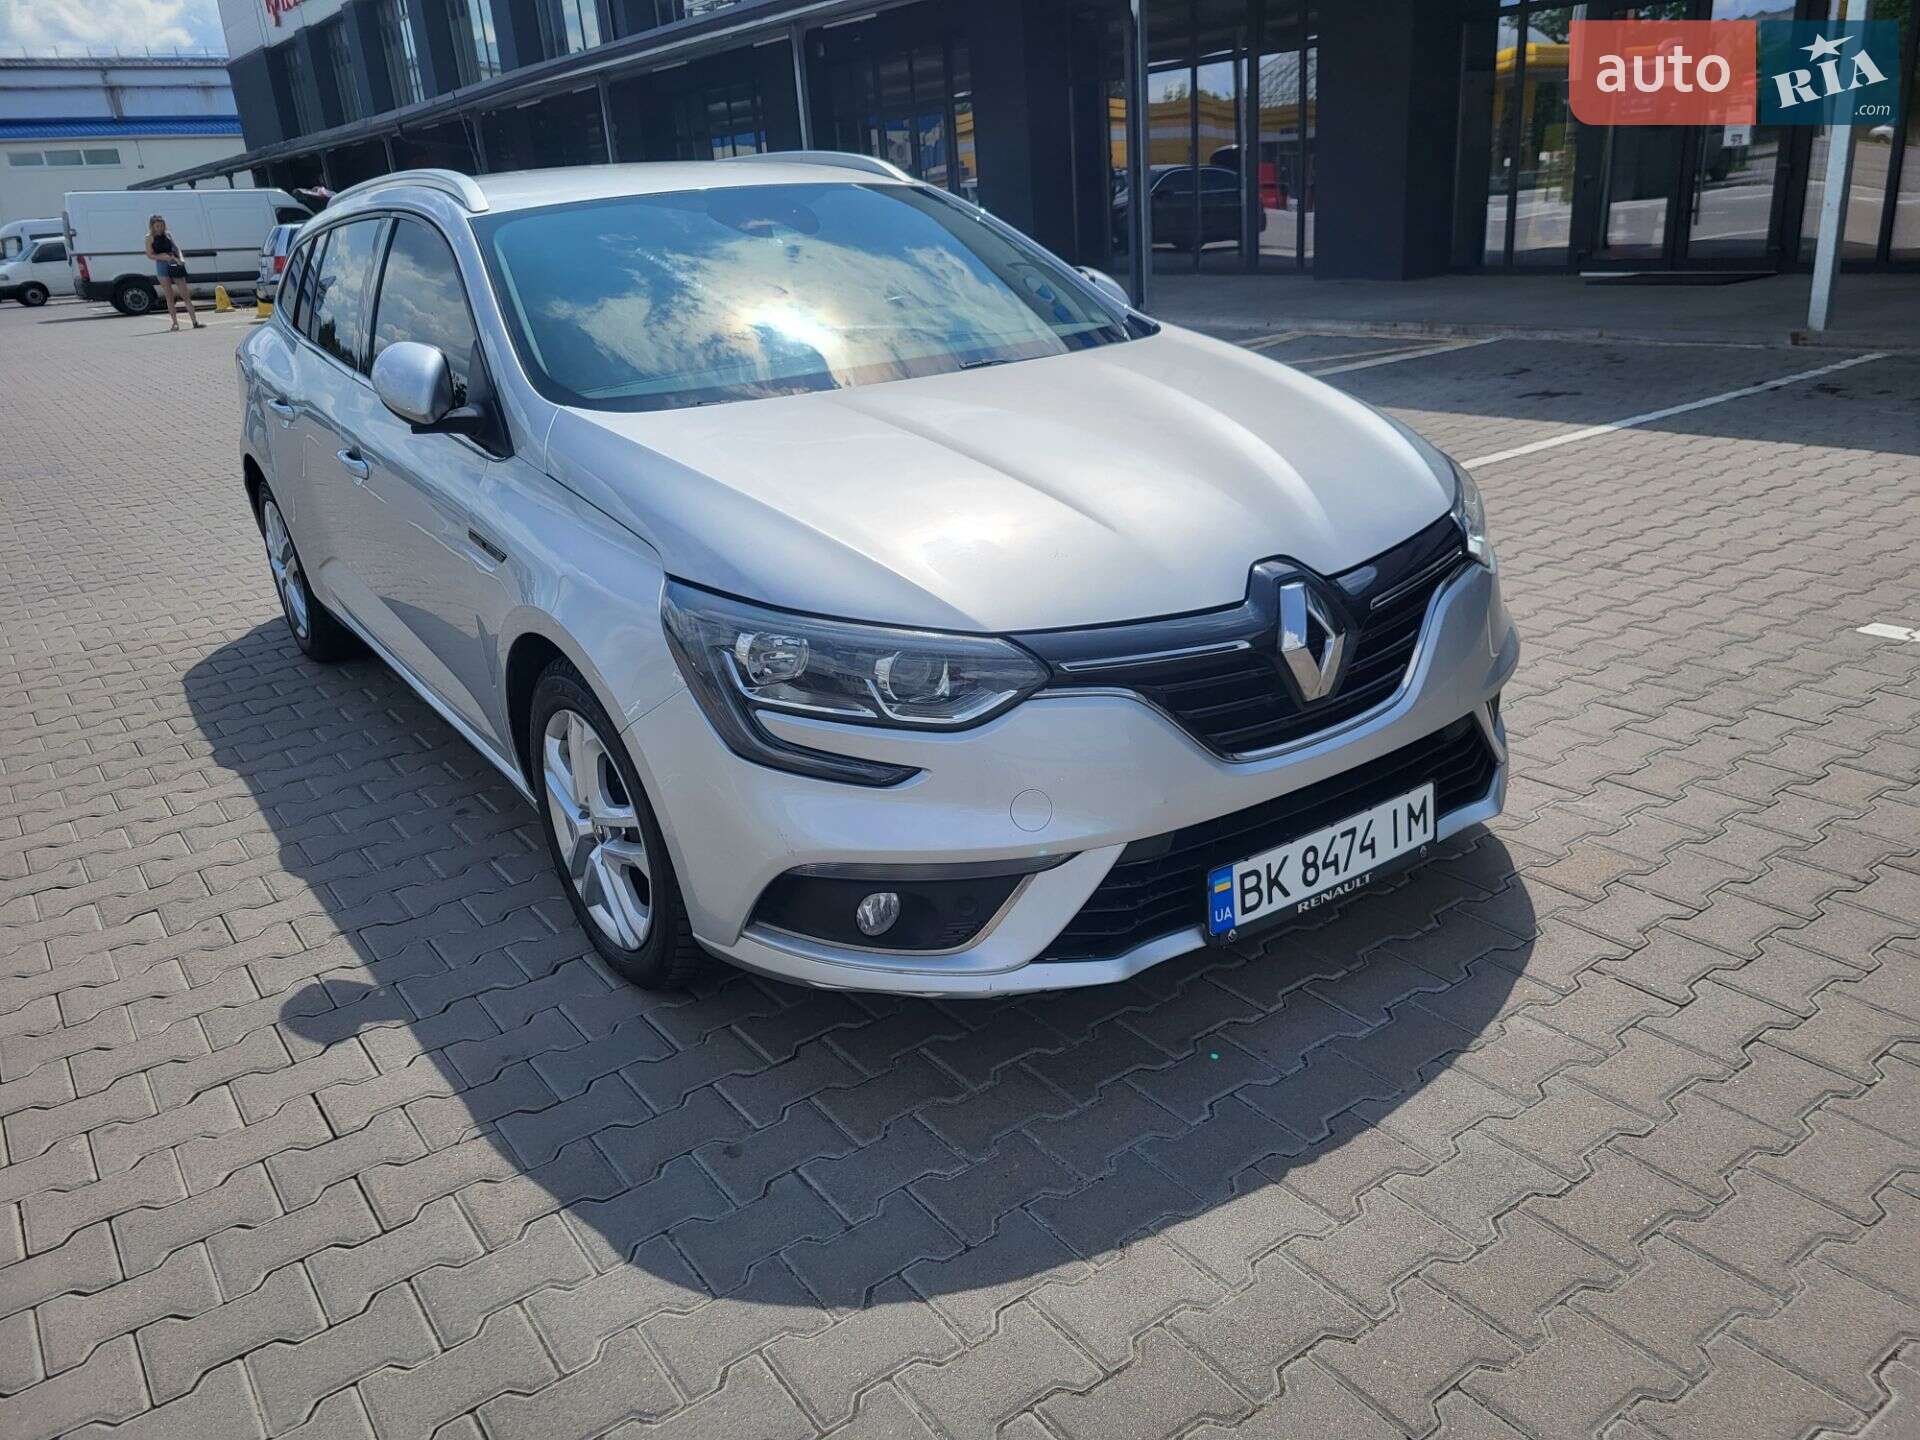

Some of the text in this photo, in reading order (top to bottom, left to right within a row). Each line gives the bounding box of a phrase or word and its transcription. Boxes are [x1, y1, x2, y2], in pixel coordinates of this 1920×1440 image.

[1239, 795, 1428, 916] BK 8474 IM
[1296, 872, 1375, 913] RENAULT
[1214, 906, 1233, 923] UA
